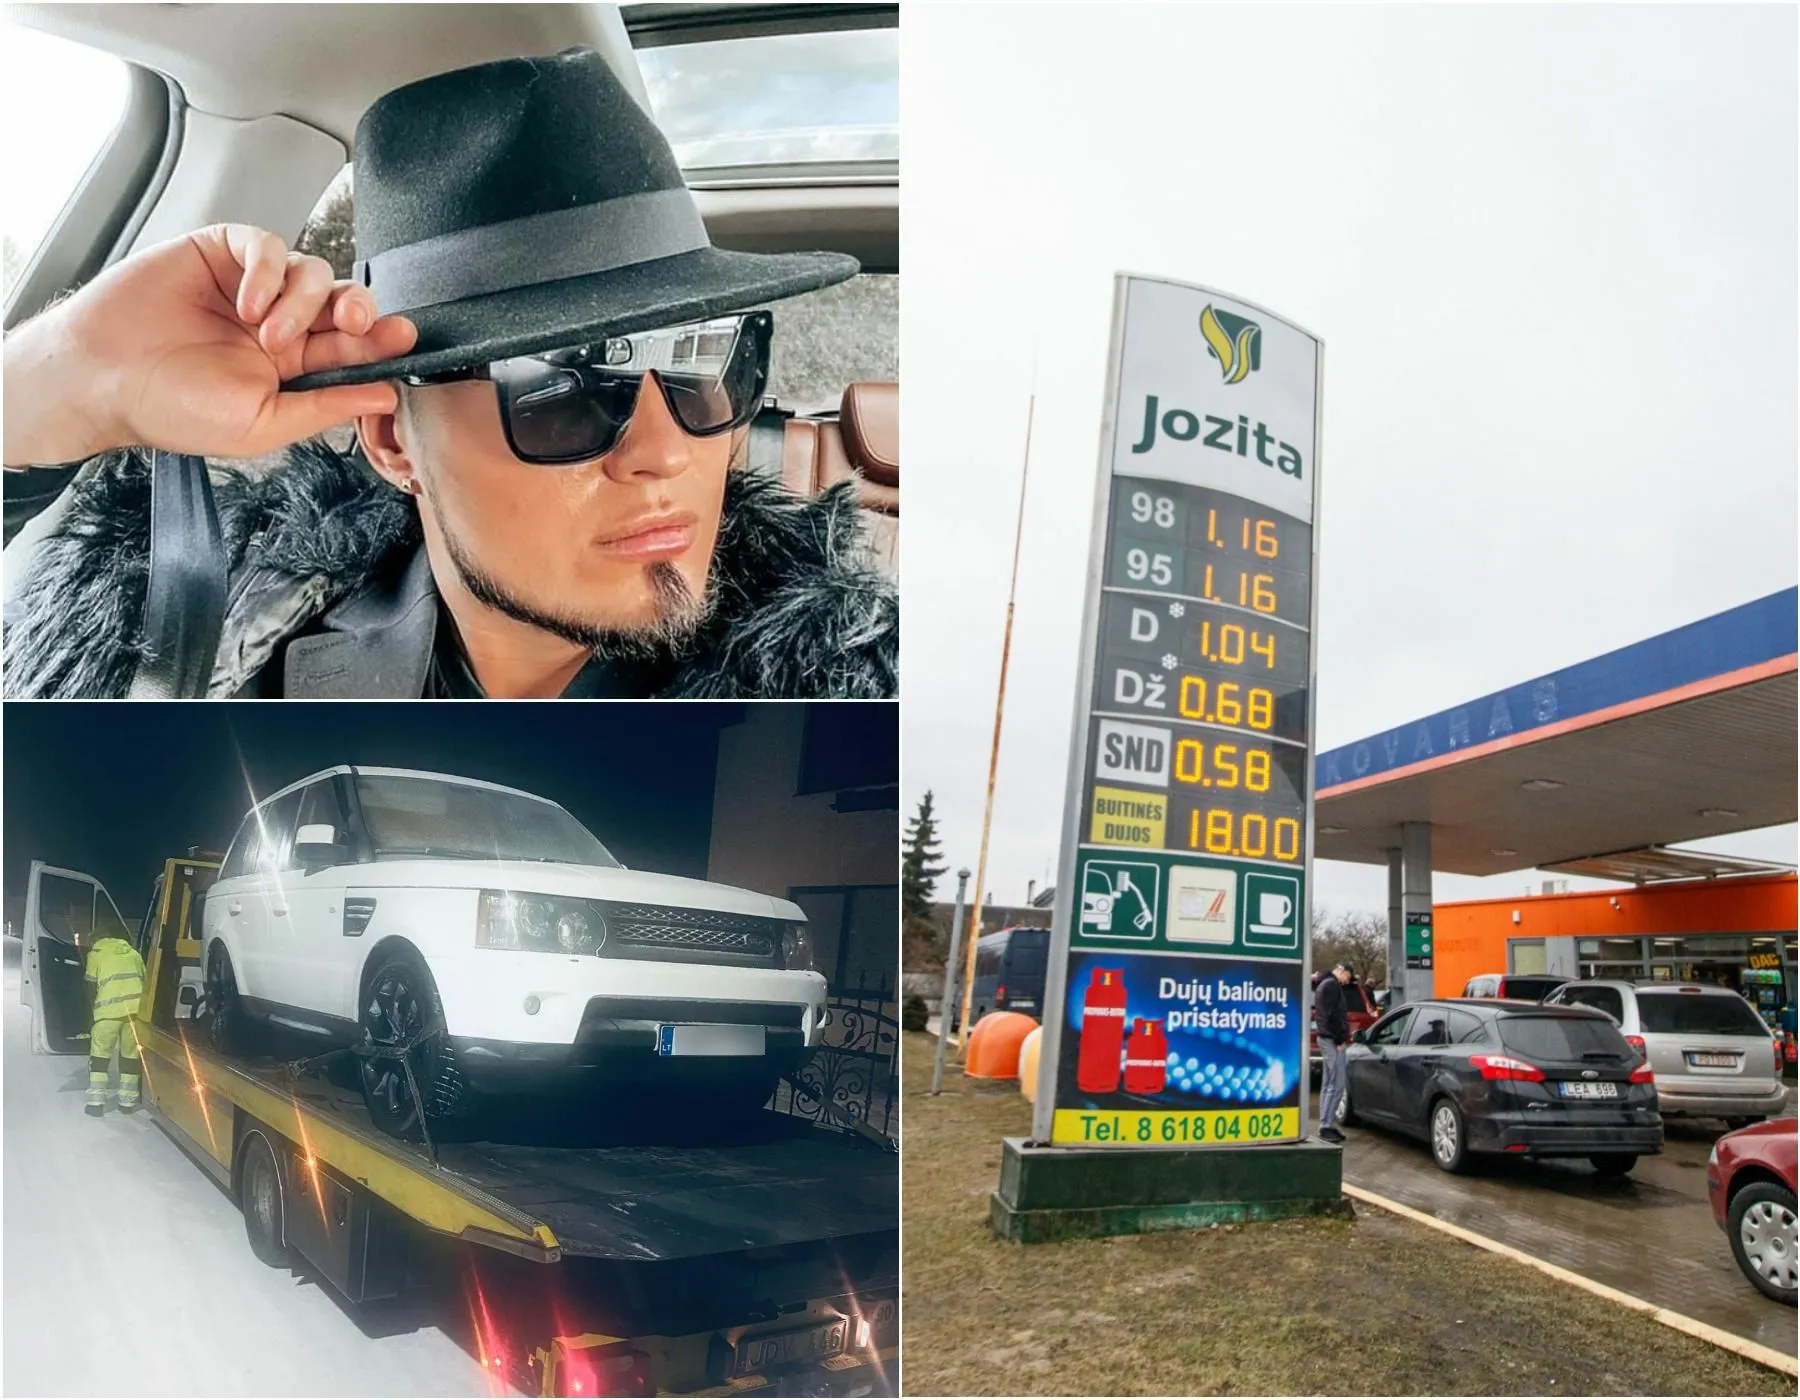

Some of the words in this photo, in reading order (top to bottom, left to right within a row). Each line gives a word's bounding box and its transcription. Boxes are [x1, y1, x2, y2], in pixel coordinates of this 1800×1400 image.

[1131, 394, 1303, 480] Jozita
[1131, 491, 1175, 528] 98
[1126, 548, 1172, 586] 95
[1130, 607, 1159, 642] D
[1201, 621, 1275, 669] 1.04
[1114, 668, 1167, 709] Dž
[1178, 674, 1273, 731] 0.68
[1104, 732, 1165, 774] SND
[1174, 738, 1271, 793] 0.58
[1095, 797, 1163, 822] BUITINĖS
[1189, 808, 1299, 861] 18.00
[1103, 822, 1151, 845] DUJOS
[1159, 977, 1212, 1005] Dujų
[1218, 980, 1288, 1007] balionų
[1167, 1008, 1287, 1033] pristatymas
[1080, 1115, 1126, 1141] Tel.
[1137, 1115, 1152, 1141] 8
[1161, 1115, 1206, 1140] 618
[1214, 1116, 1241, 1139] 04
[1248, 1113, 1284, 1137] 082
